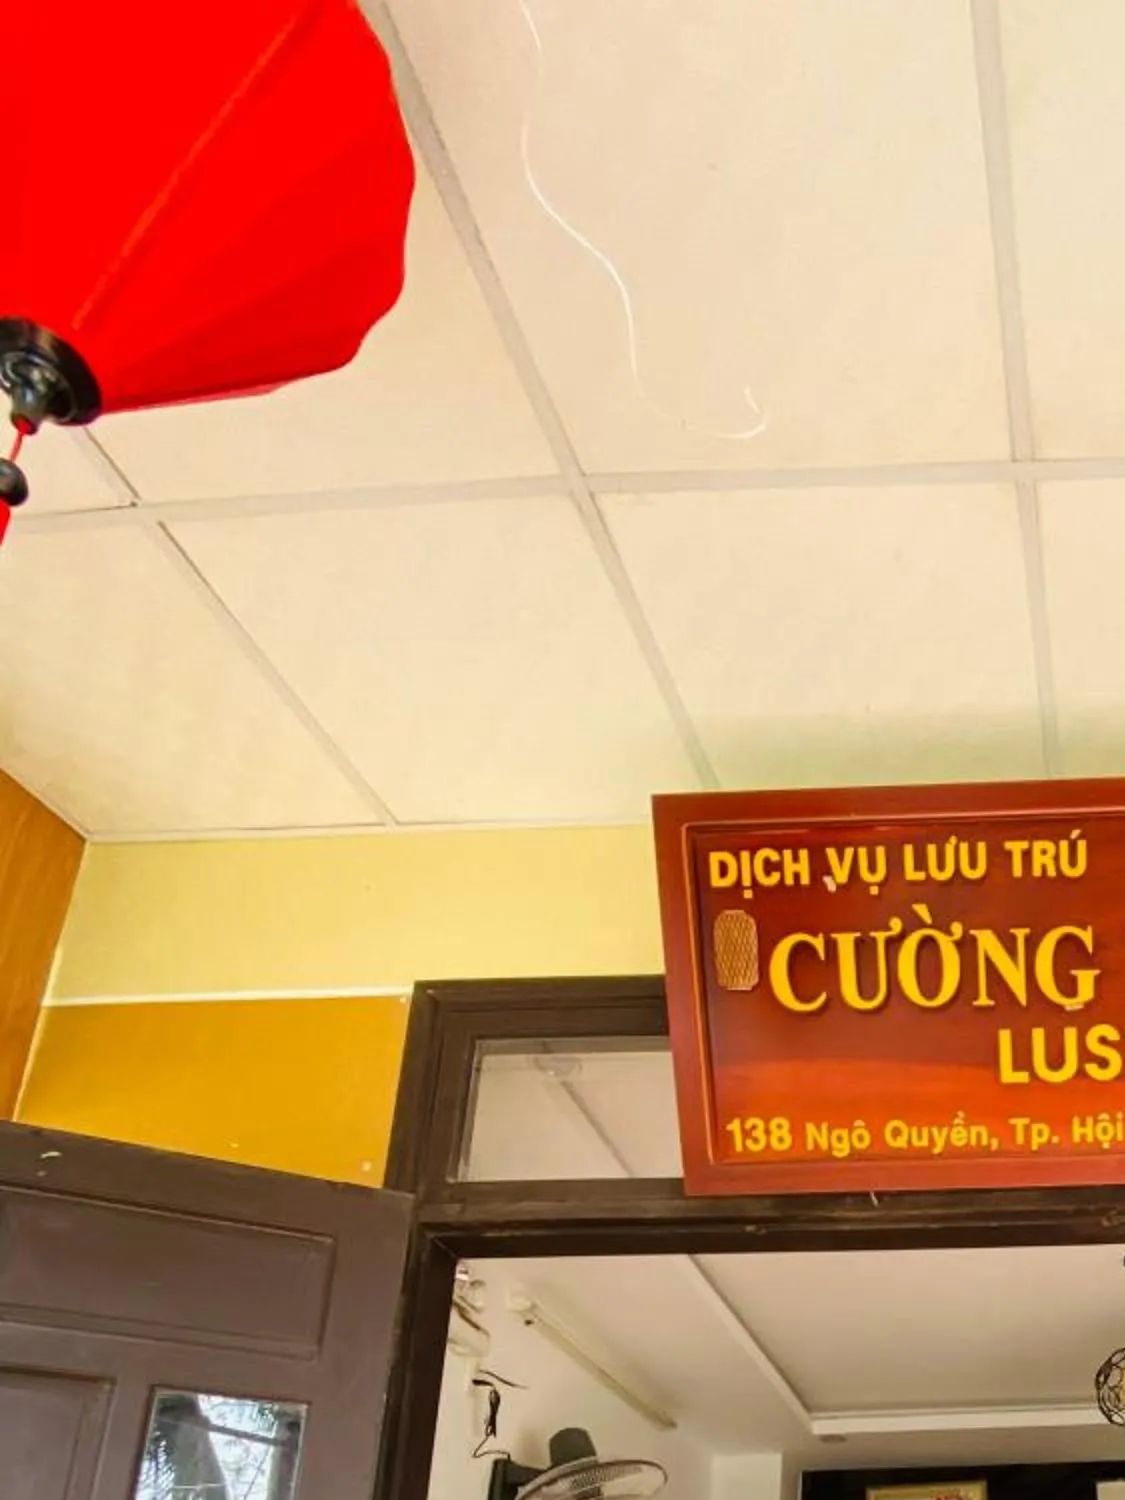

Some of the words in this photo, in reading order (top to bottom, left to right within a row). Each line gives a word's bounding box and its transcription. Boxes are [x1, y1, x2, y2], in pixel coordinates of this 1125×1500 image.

[709, 848, 810, 899] DỊCH
[826, 845, 887, 895] VỤ
[903, 836, 987, 881] LƯU
[1004, 829, 1087, 877] TRÚ
[769, 903, 1101, 1012] CƯỜNG
[726, 1117, 793, 1153] 138
[805, 1119, 871, 1158] Ngô
[883, 1111, 999, 1156] Quyền,
[1008, 1117, 1060, 1151] Tp.
[1071, 1111, 1125, 1150] Hội
